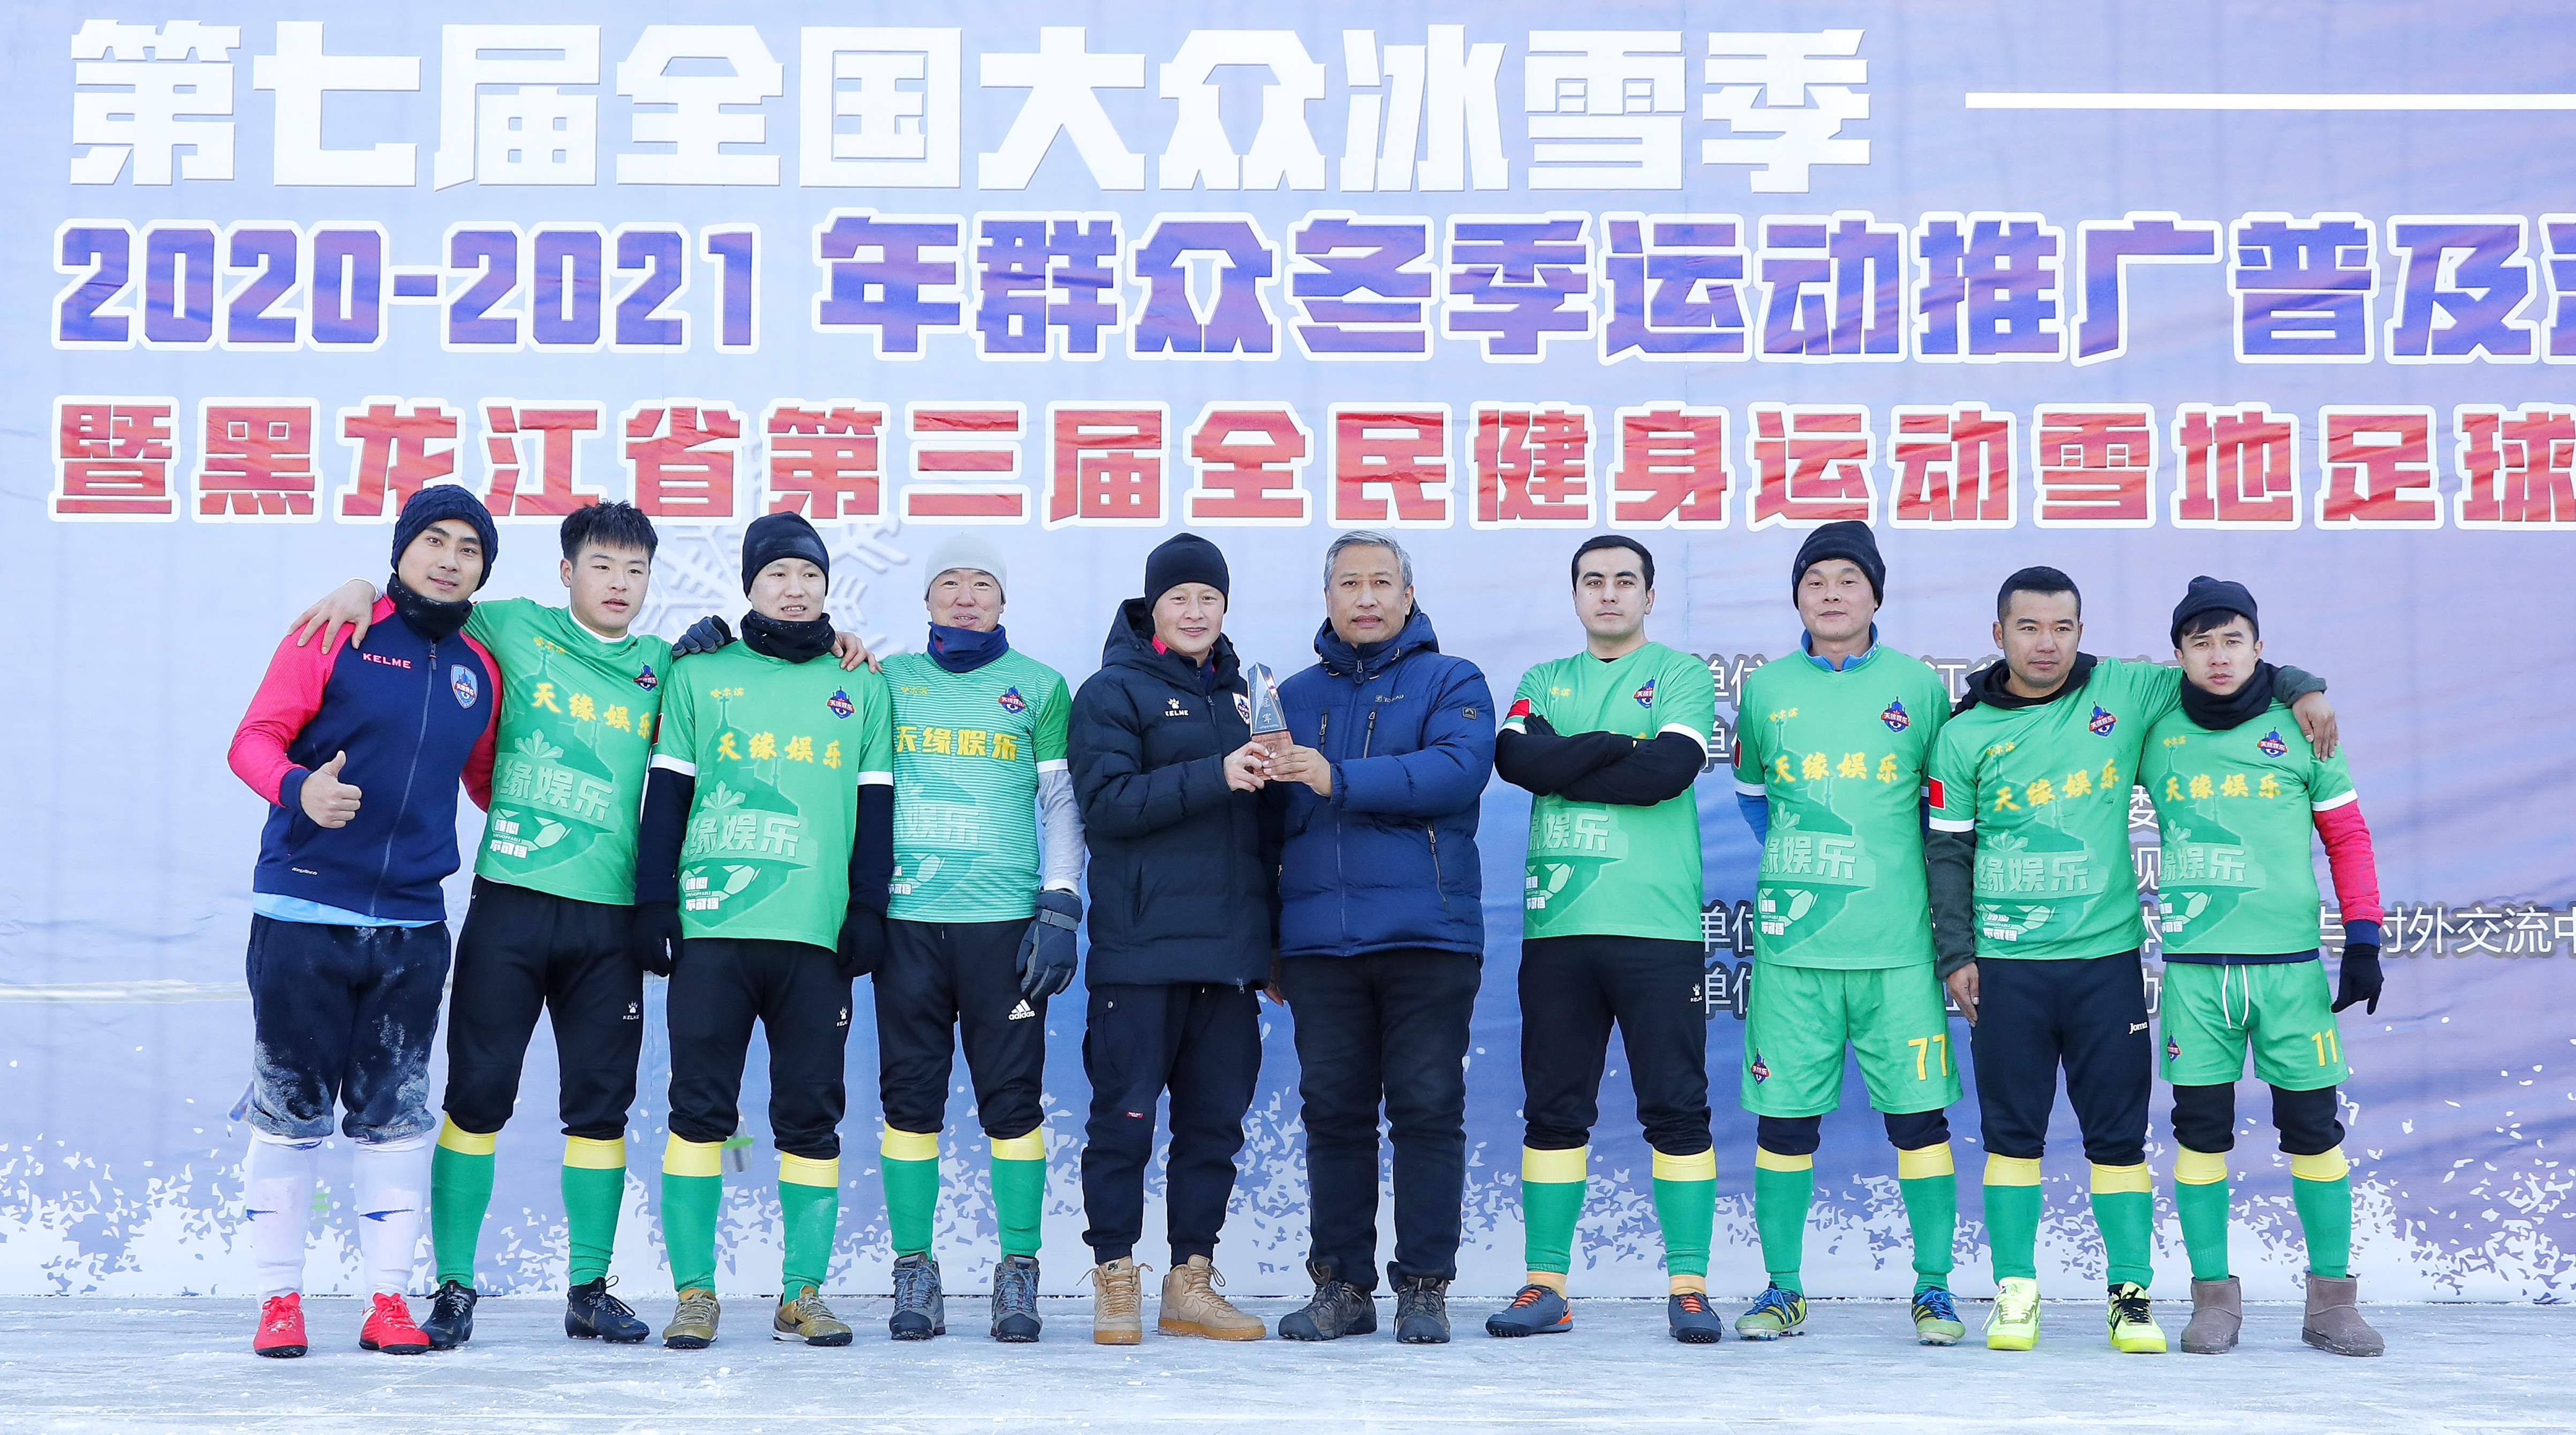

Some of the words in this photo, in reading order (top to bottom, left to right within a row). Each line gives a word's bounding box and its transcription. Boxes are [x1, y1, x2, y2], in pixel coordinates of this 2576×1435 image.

[70, 18, 1871, 193] 第七届全国大众冰雪季
[56, 223, 755, 349] 2020-2021
[817, 214, 2576, 360] 年群众冬季运动推广普及
[56, 402, 2576, 522] 暨黑龙江省第三届全民健身运动雪地足球
[362, 653, 411, 669] KELME
[717, 731, 842, 769] 天缘娱乐
[896, 726, 1018, 761] 天缘娱乐
[1773, 751, 1898, 784] 天缘娱乐
[1993, 758, 2119, 812] 天缘娱乐
[2165, 773, 2282, 802] 天缘娱乐
[682, 814, 800, 857] 缘娱乐
[1008, 1010, 1036, 1021] adidas
[2129, 1022, 2148, 1034] Joma
[1907, 1033, 1948, 1081] 77
[2311, 1029, 2338, 1067] 11
